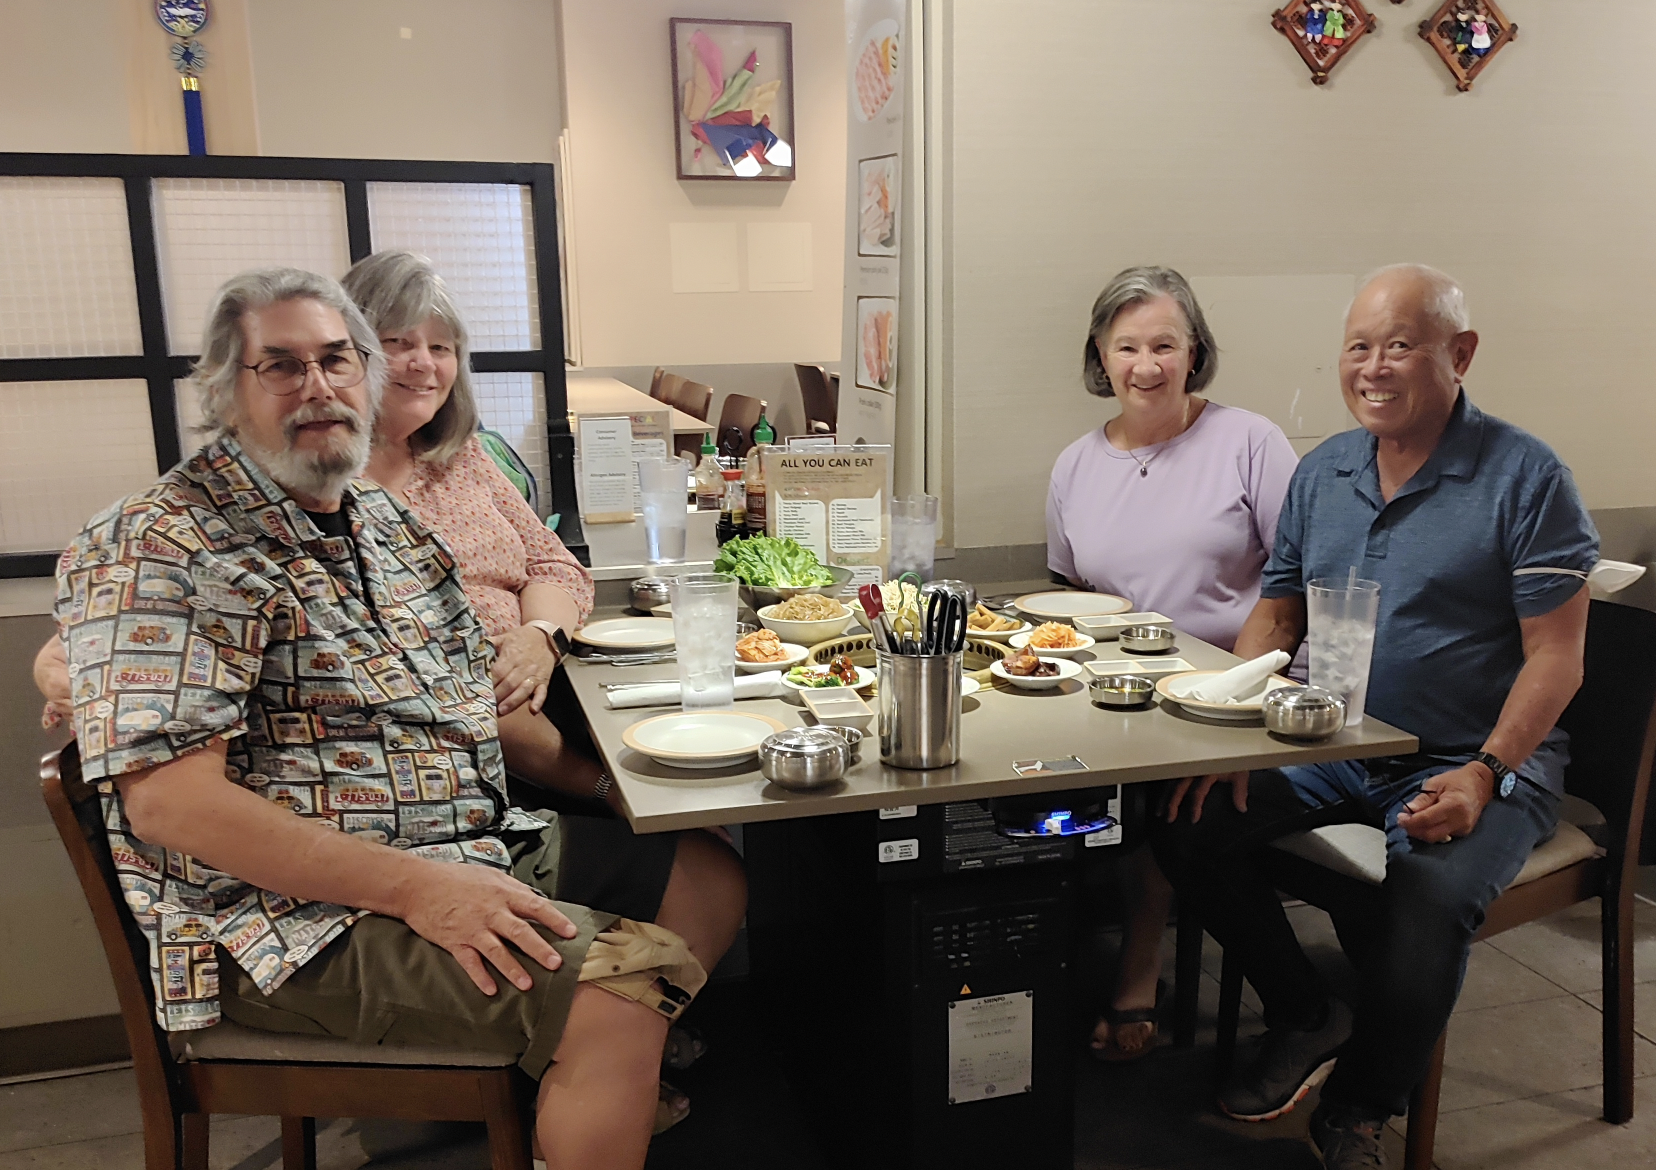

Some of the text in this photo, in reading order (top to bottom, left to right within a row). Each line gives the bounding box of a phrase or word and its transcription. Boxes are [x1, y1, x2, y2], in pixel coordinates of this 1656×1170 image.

[780, 458, 874, 468] ALL YOU CAN EAT
